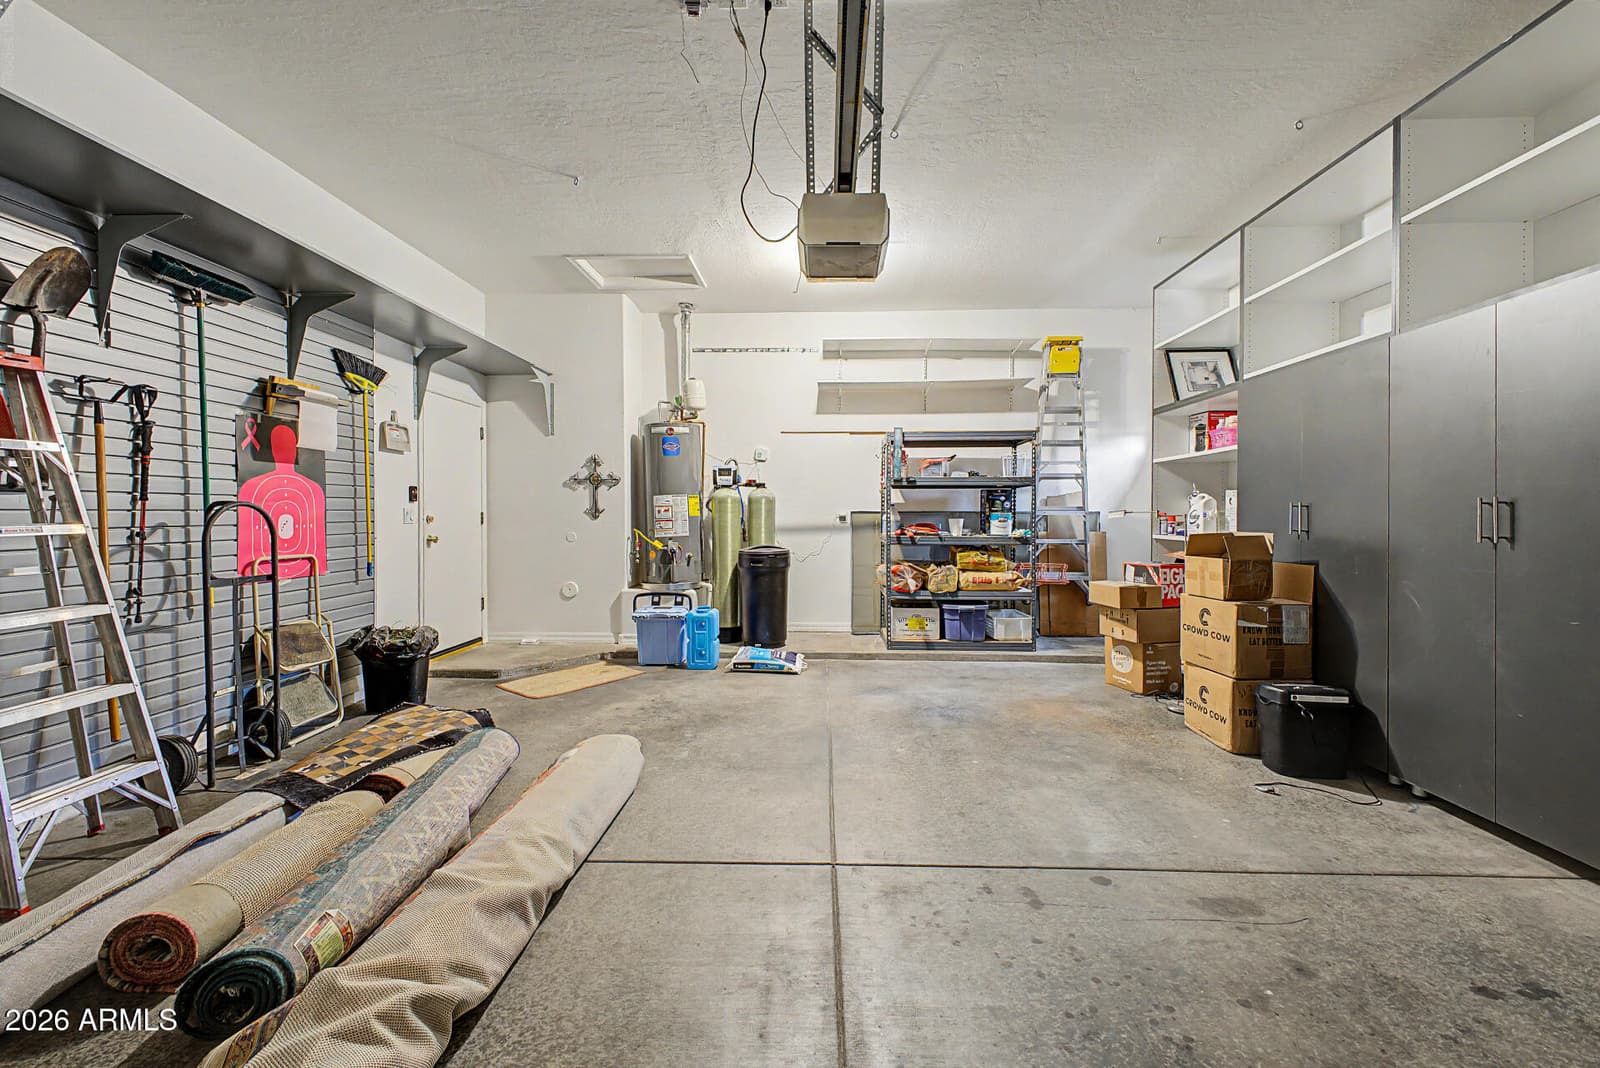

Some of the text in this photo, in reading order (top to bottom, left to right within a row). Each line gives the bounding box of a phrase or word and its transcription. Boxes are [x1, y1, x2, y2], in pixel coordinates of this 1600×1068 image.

[1182, 623, 1231, 643] CROWD COW
[1185, 697, 1227, 725] CROWD COW
